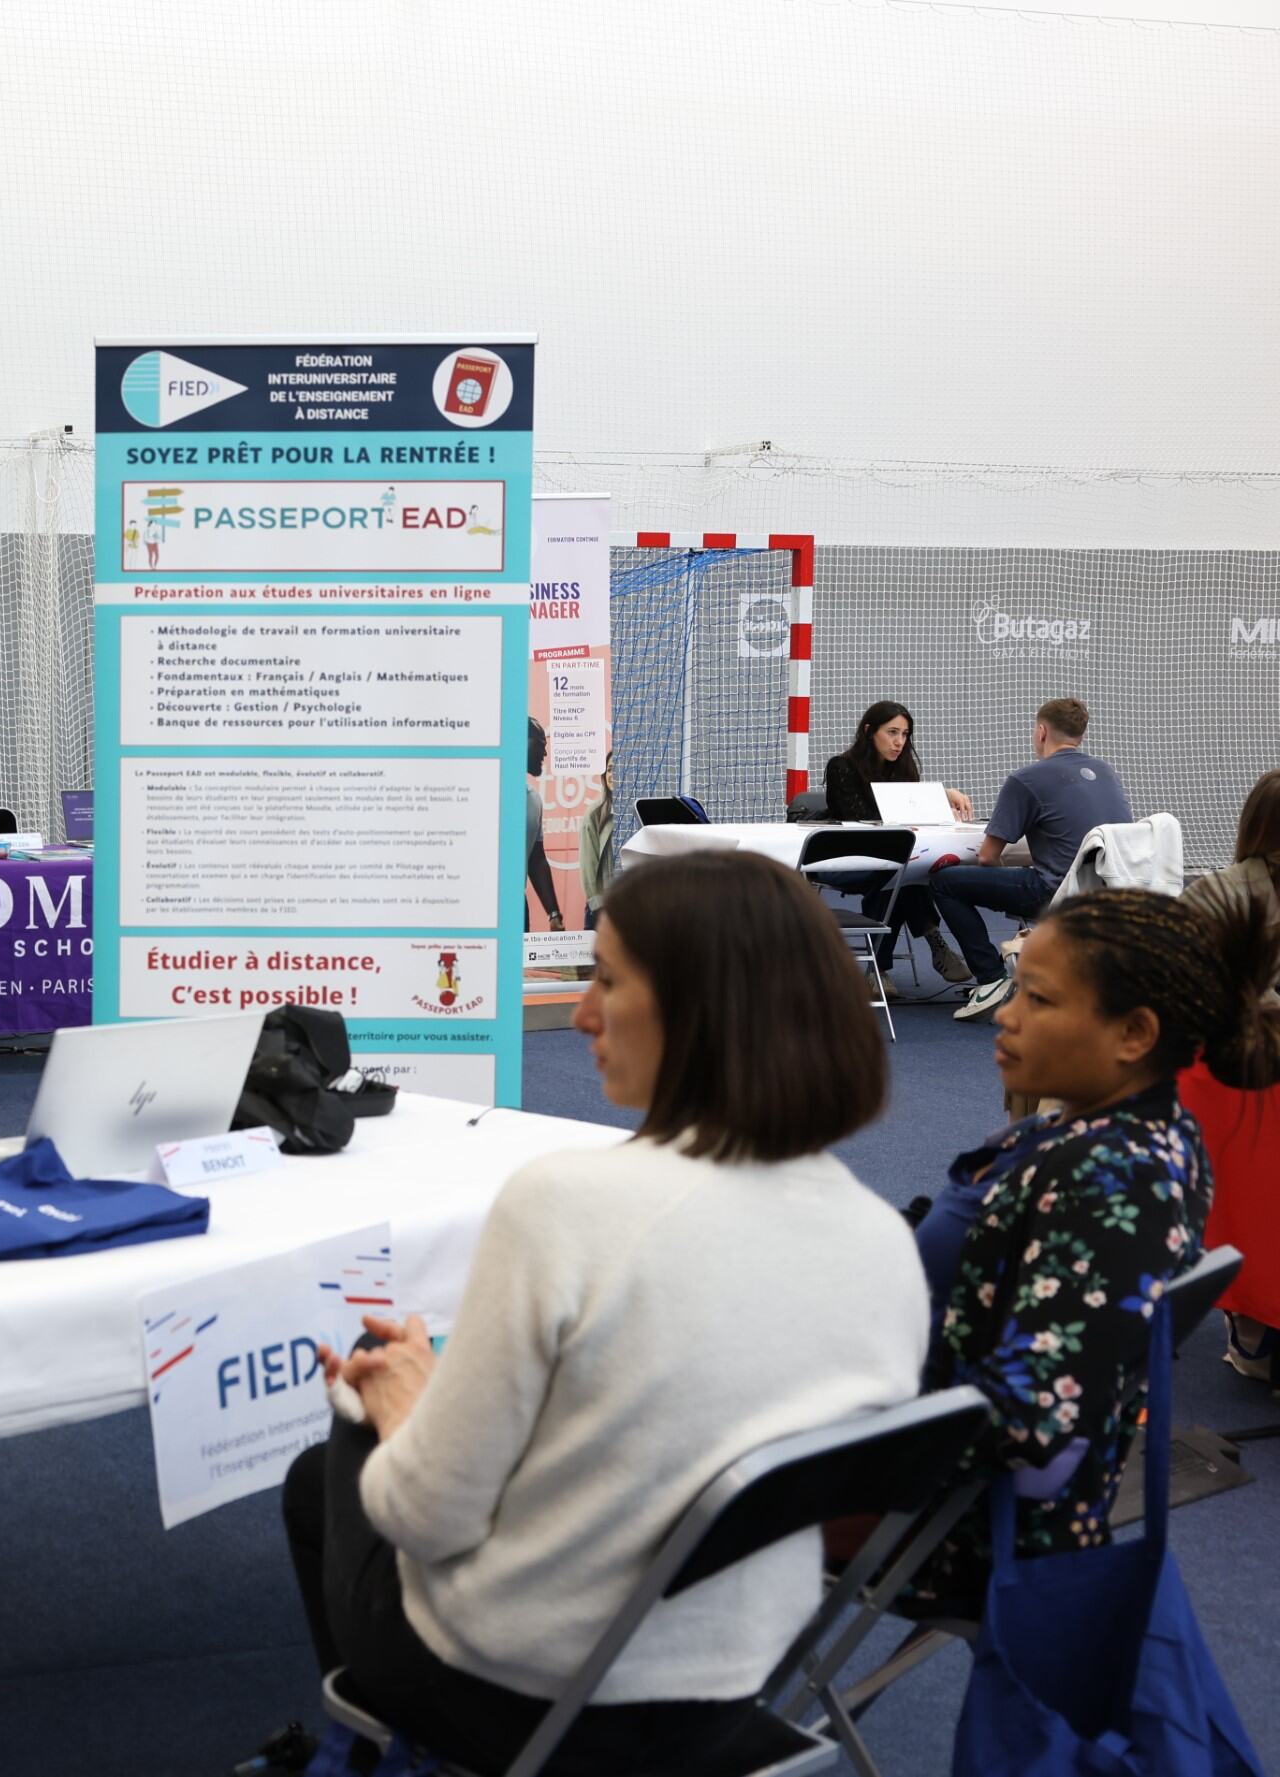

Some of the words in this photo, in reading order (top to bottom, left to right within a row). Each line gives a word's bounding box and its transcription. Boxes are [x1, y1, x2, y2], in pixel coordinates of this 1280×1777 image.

[294, 352, 372, 367] FÉDÉRATION
[267, 372, 397, 385] INTERUNIVERSITAIRE
[168, 380, 209, 396] FIED
[269, 390, 286, 402] DE
[287, 389, 394, 402] L'ENSEIGNEMENT
[294, 405, 305, 420] À
[306, 407, 368, 420] DISTANCE
[126, 446, 198, 465] SOYEZ
[207, 441, 262, 464] PRÊT
[270, 446, 333, 464] POUR
[343, 446, 370, 464] LA
[380, 441, 479, 464] RENTRÉE
[488, 445, 495, 463] !
[194, 507, 384, 529] PASSEPORT
[402, 507, 467, 529] EAD
[133, 584, 223, 601] Préparation
[229, 588, 256, 598] aux
[261, 584, 312, 598] études
[318, 584, 423, 598] universitaires
[429, 588, 447, 598] en
[453, 584, 491, 602] ligne
[156, 624, 237, 638] Méthodologie
[241, 625, 256, 635] de
[258, 624, 298, 635] travail
[302, 627, 317, 635] en
[320, 624, 380, 636] formation
[384, 624, 461, 636] universitaire
[994, 613, 1091, 645] Butagaz
[156, 639, 164, 650] à
[167, 639, 217, 651] distance
[156, 655, 216, 666] Recherche
[219, 655, 300, 666] documentaire
[538, 647, 585, 659] PROGRAMME
[562, 661, 600, 669] PART-TIME
[553, 676, 569, 690] 12
[146, 946, 238, 970] Étudier
[244, 950, 258, 970] à
[266, 950, 380, 974] distance,
[171, 985, 232, 1004] C'est
[239, 984, 343, 1010] possible
[350, 986, 356, 1005] !
[411, 994, 464, 1015] PASSEPORT
[465, 996, 484, 1011] EAD
[396, 1034, 420, 1043] pour
[423, 1034, 448, 1042] vous
[450, 1033, 494, 1043] assister.
[201, 1154, 246, 1173] BENOIT
[217, 1336, 321, 1410] FIED
